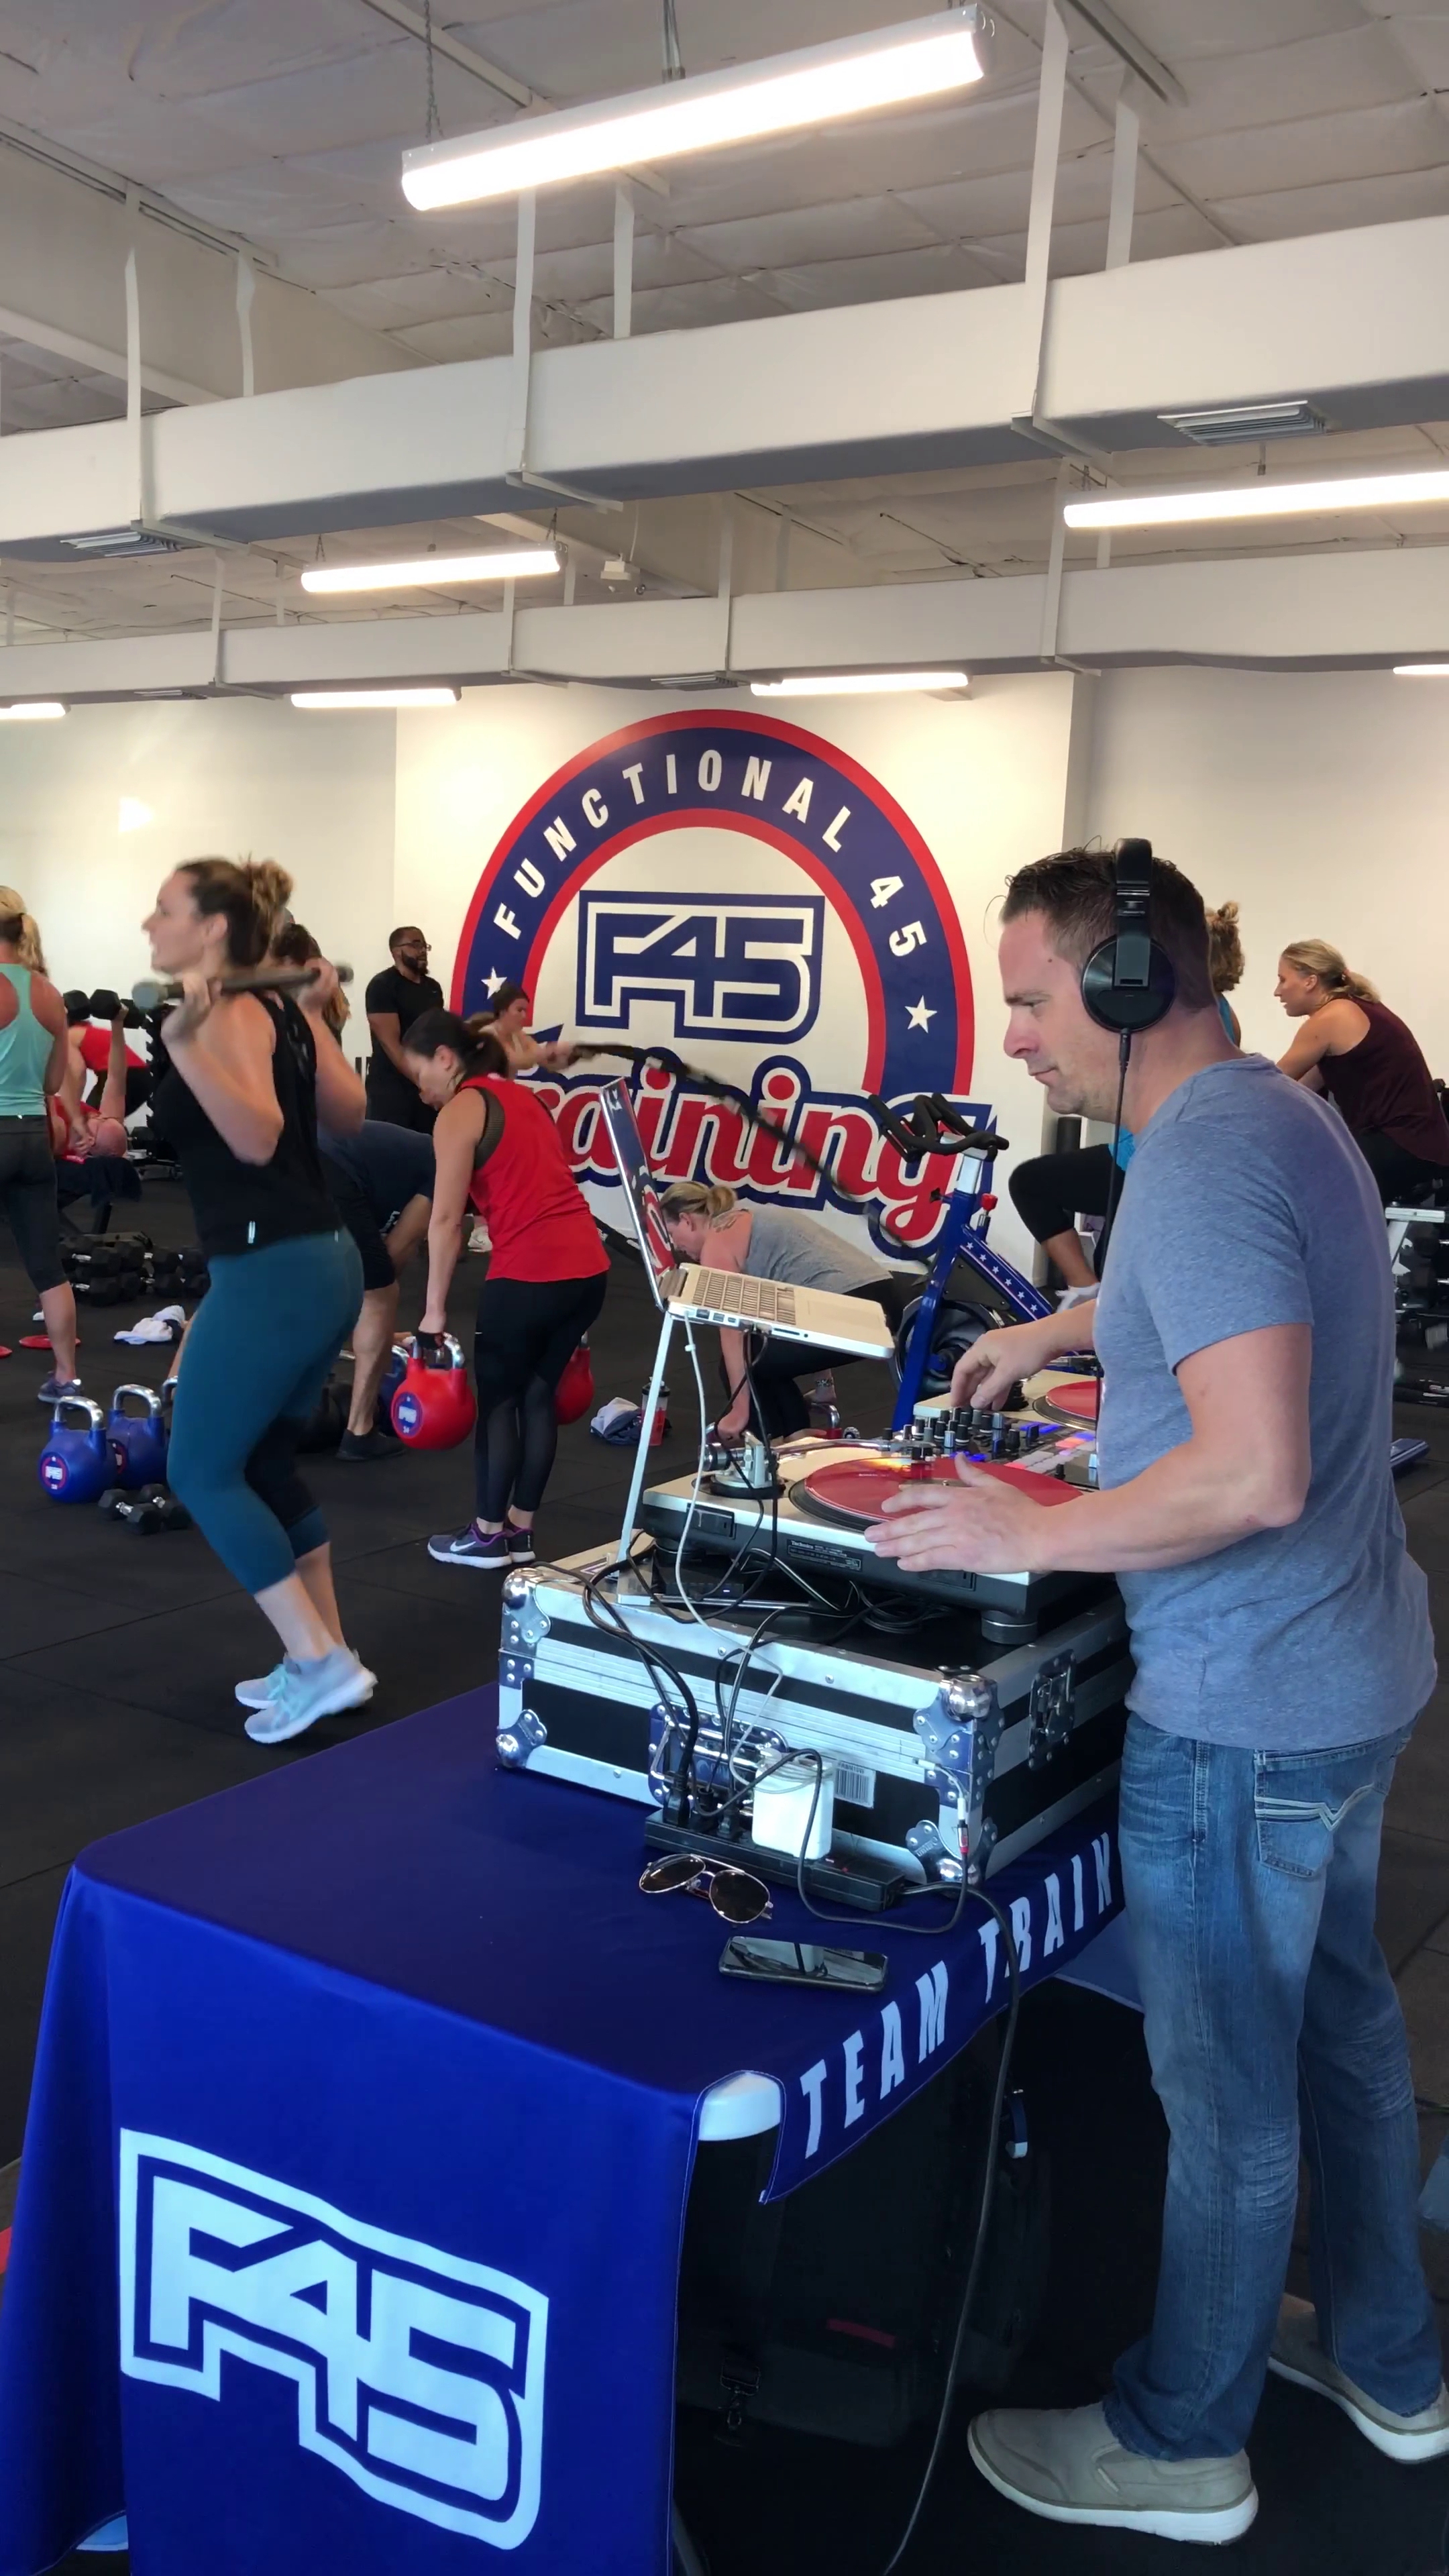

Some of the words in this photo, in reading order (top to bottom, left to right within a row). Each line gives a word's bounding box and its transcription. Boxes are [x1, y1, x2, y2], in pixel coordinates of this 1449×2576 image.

[493, 749, 852, 940] FUNCTIONAL
[869, 874, 928, 958] 45
[581, 898, 818, 1037] F45
[518, 1055, 969, 1252] aining
[800, 1960, 950, 2160] TEAM
[125, 2133, 545, 2544] F45
